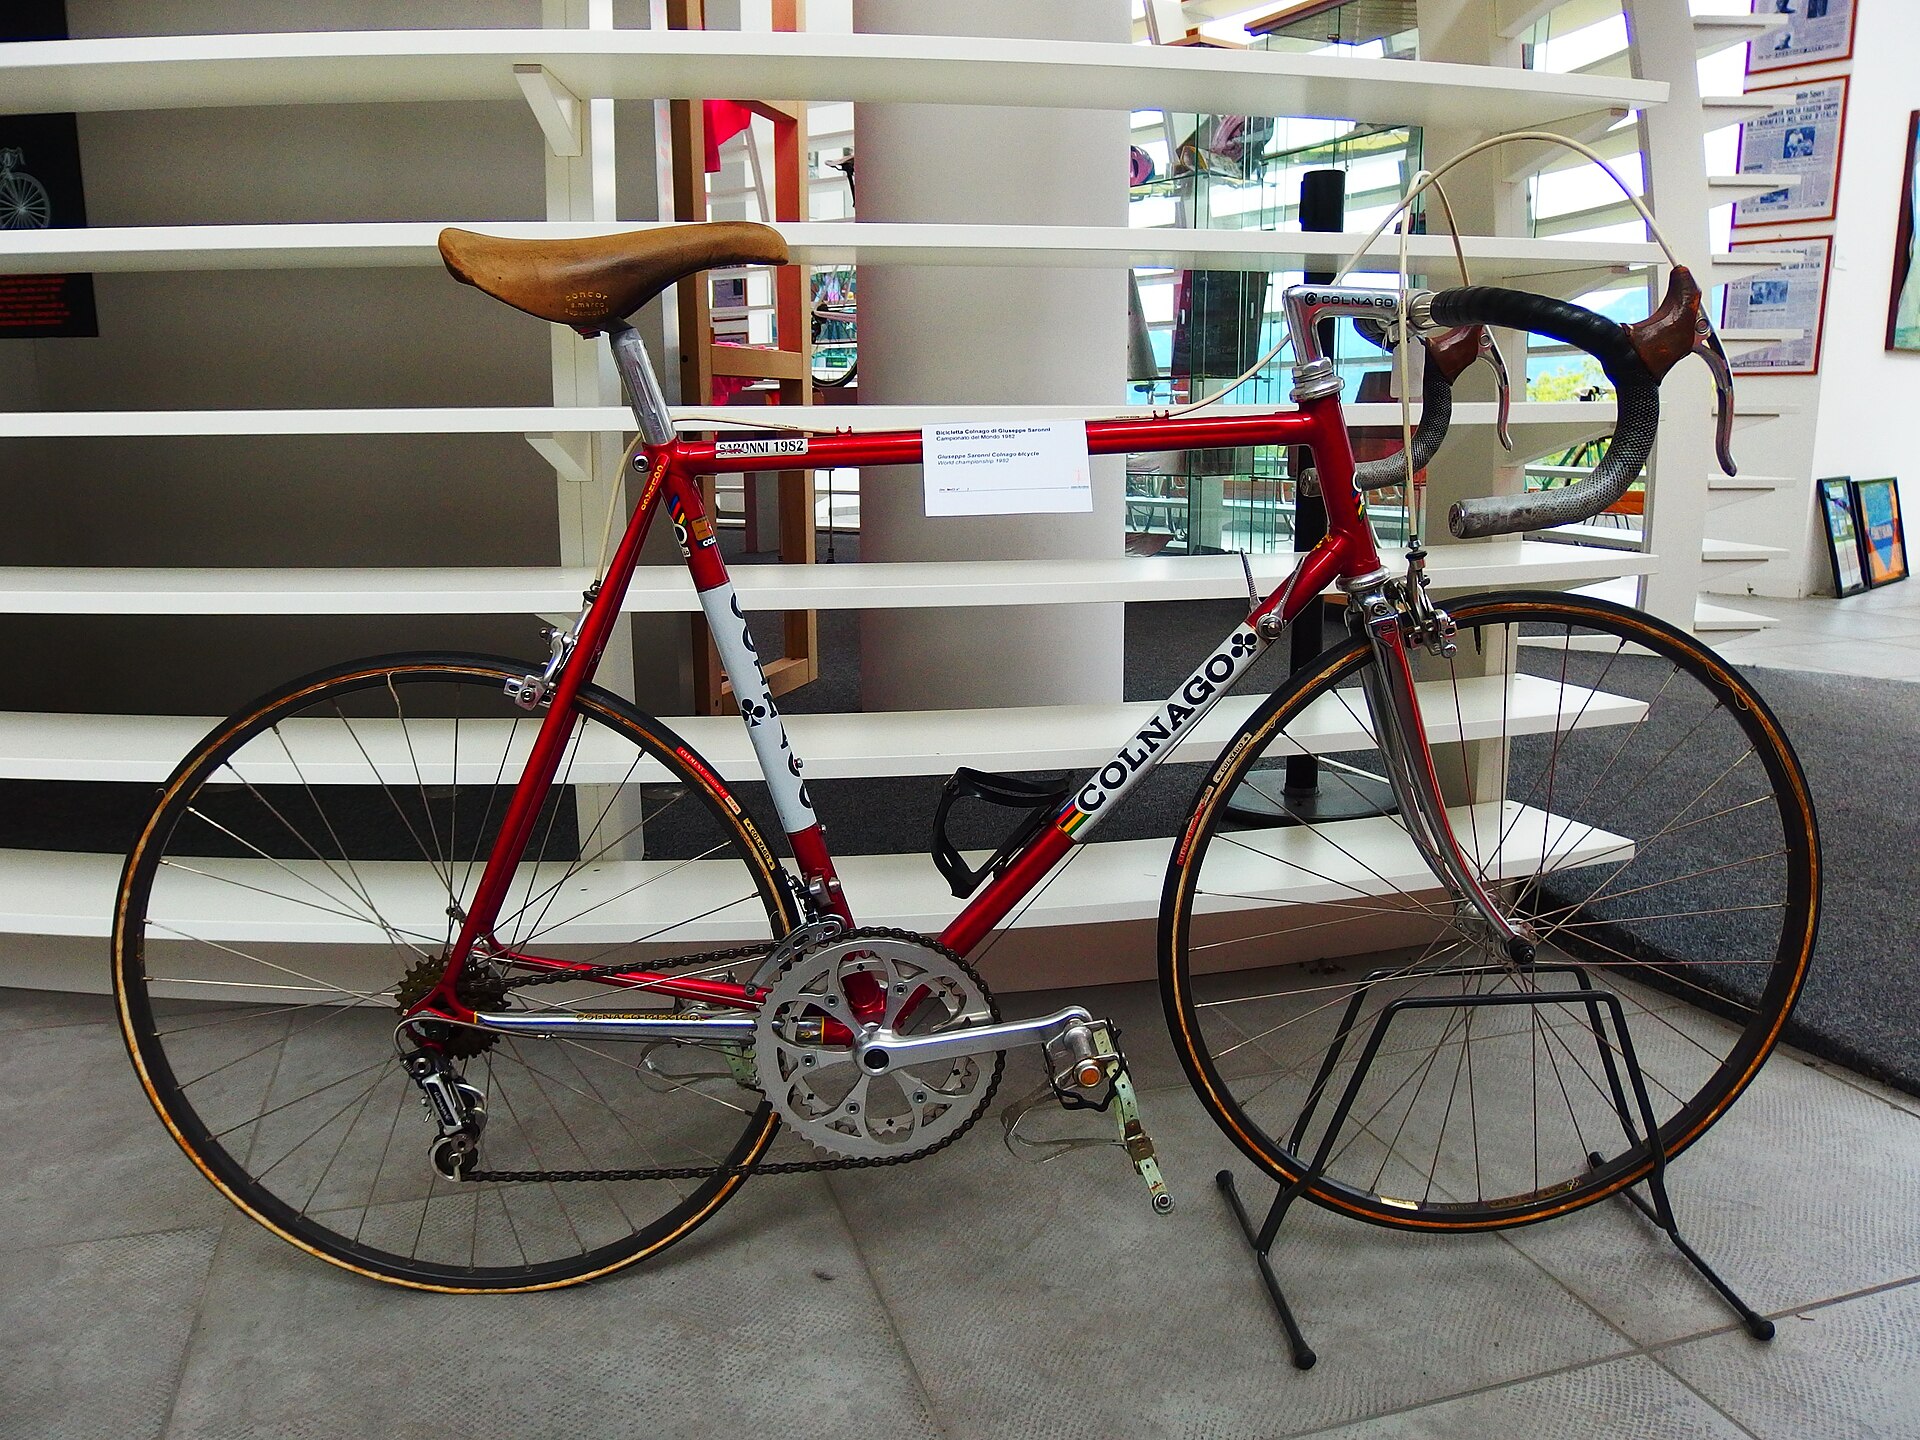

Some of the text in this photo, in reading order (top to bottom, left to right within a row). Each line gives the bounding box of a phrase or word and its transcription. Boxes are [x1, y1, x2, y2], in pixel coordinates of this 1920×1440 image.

[565, 291, 608, 302] concor
[1321, 295, 1394, 308] COLNAGO
[719, 440, 804, 455] SARONNI 1982
[641, 464, 663, 511] COLNAGO
[1076, 653, 1235, 812] COLNAGO
[680, 749, 705, 772] CLEMENT
[750, 827, 771, 860] COLNAGO
